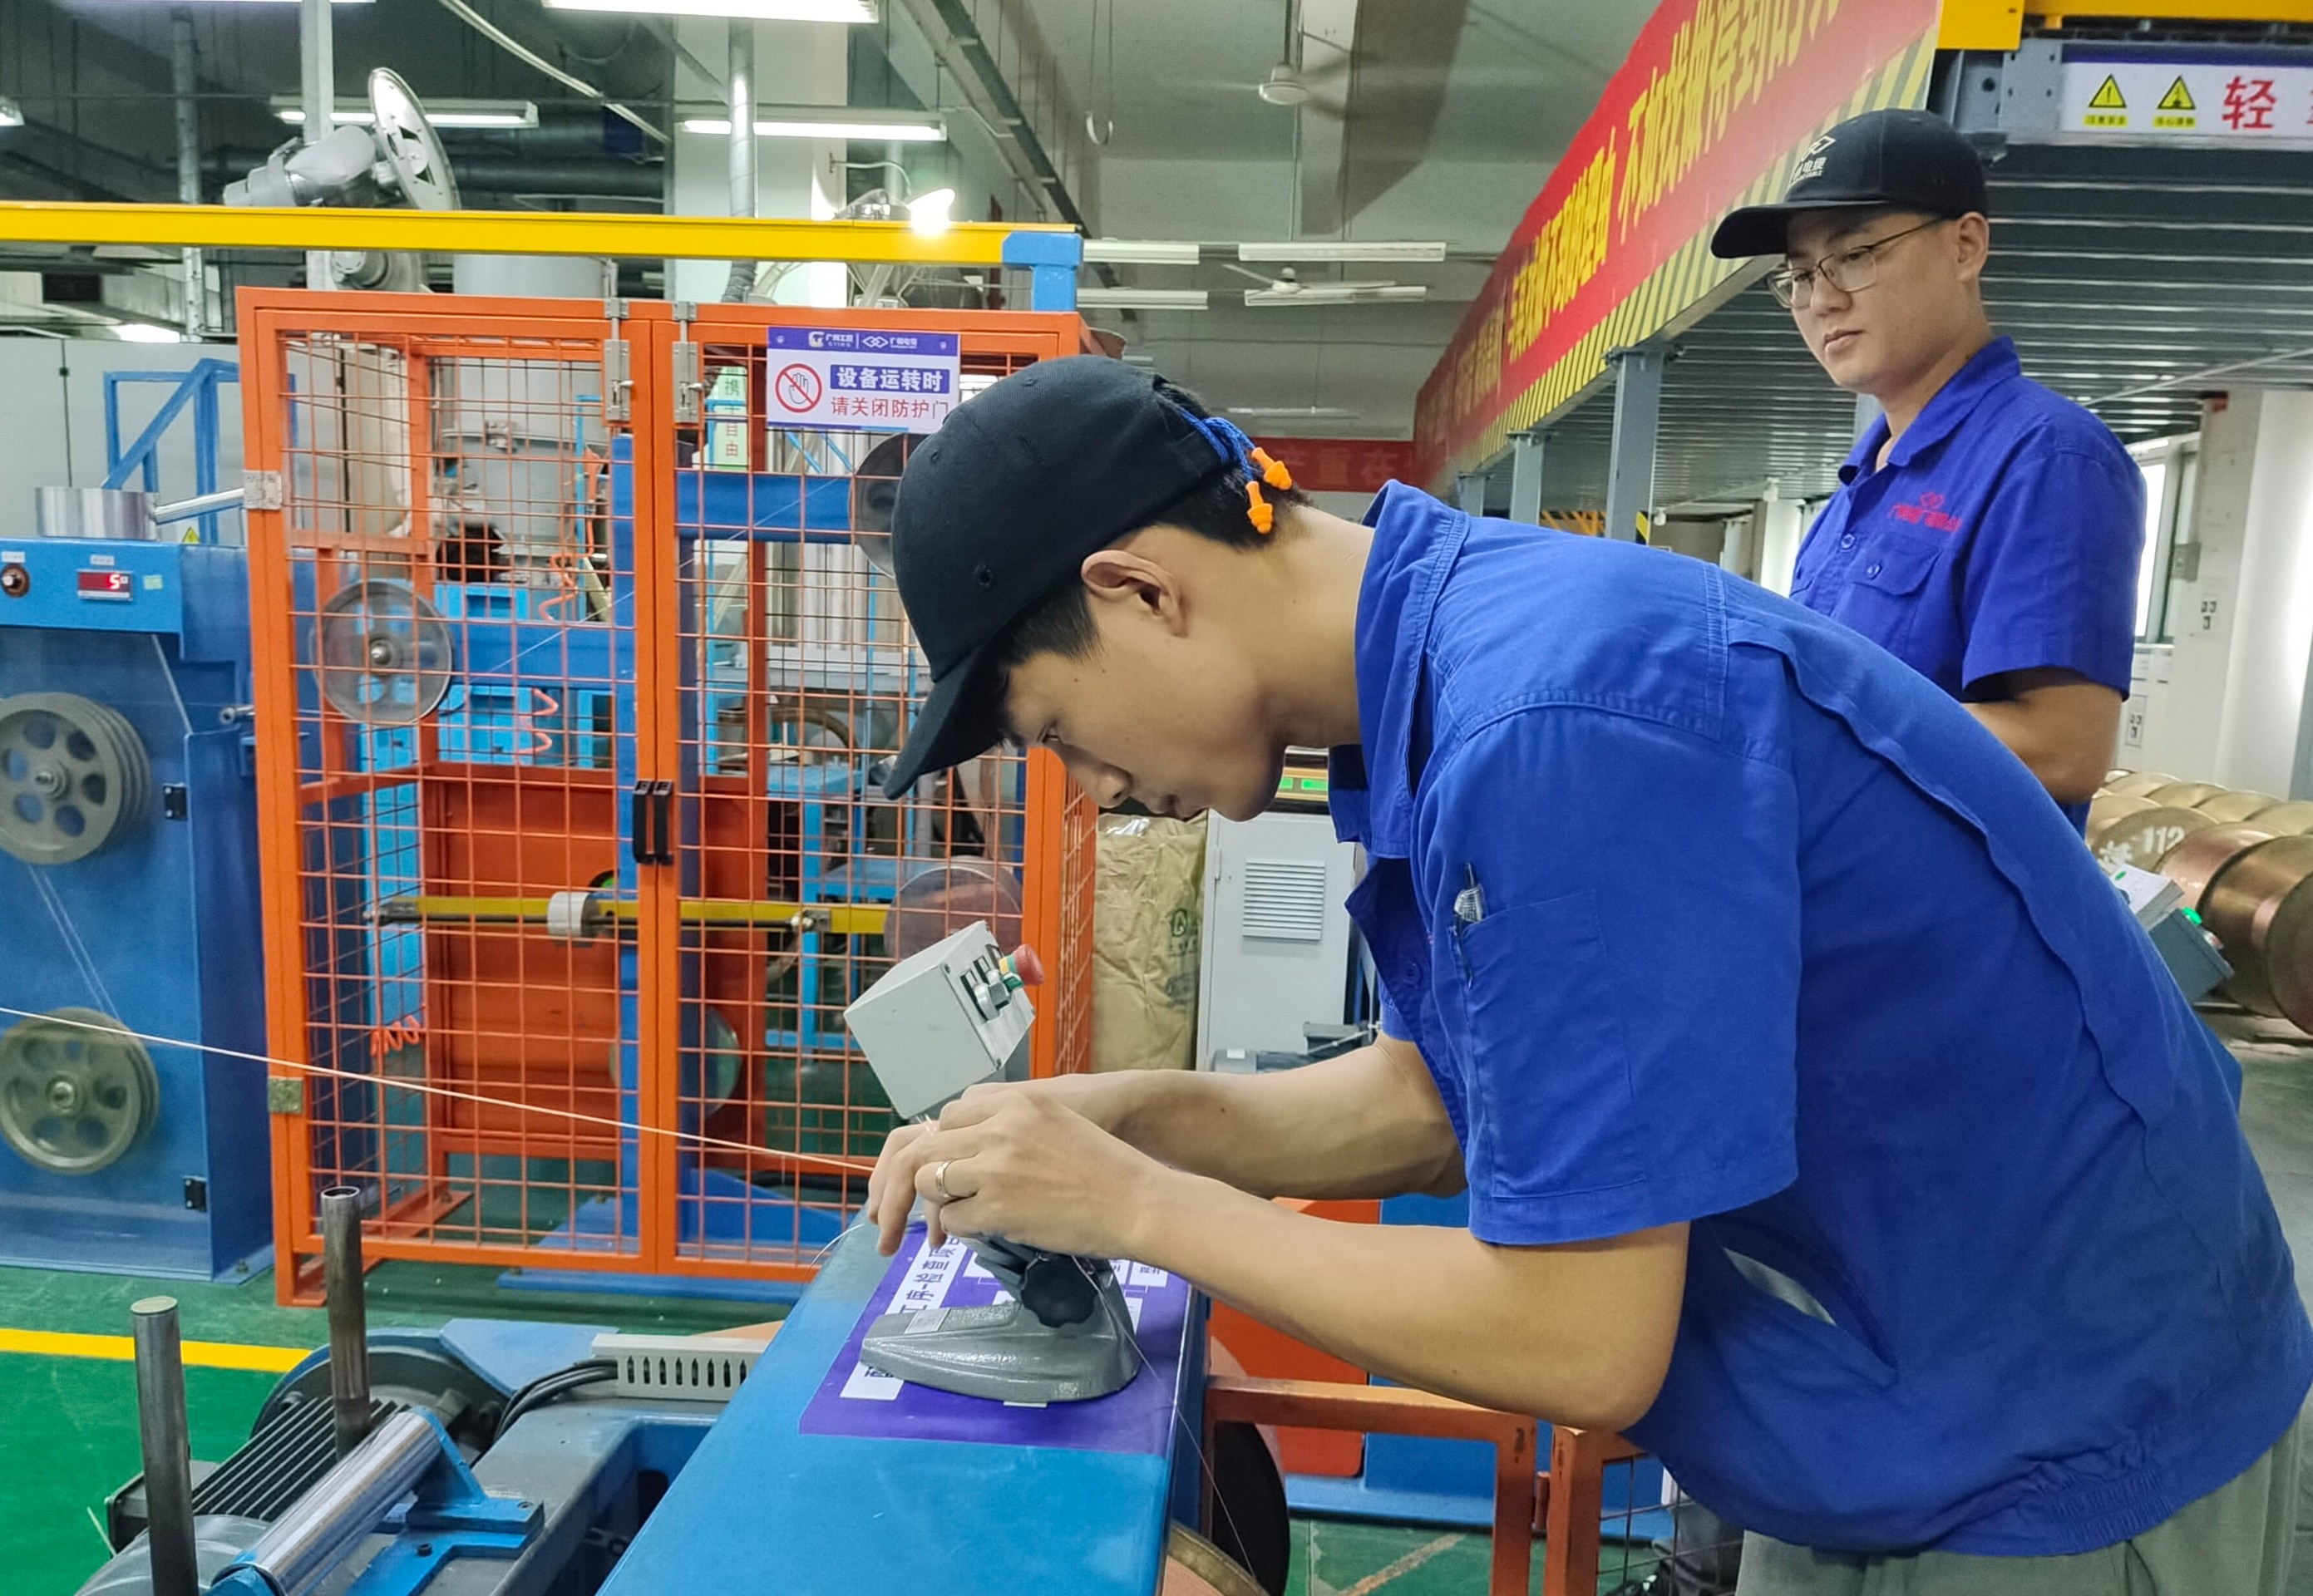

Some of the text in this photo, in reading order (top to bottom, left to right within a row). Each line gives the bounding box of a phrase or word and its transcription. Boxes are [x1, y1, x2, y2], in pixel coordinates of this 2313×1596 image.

[2222, 76, 2276, 130] 轻
[836, 367, 944, 392] 设备运转时
[831, 396, 949, 419] 请关闭防护门
[2143, 826, 2186, 855] 112
